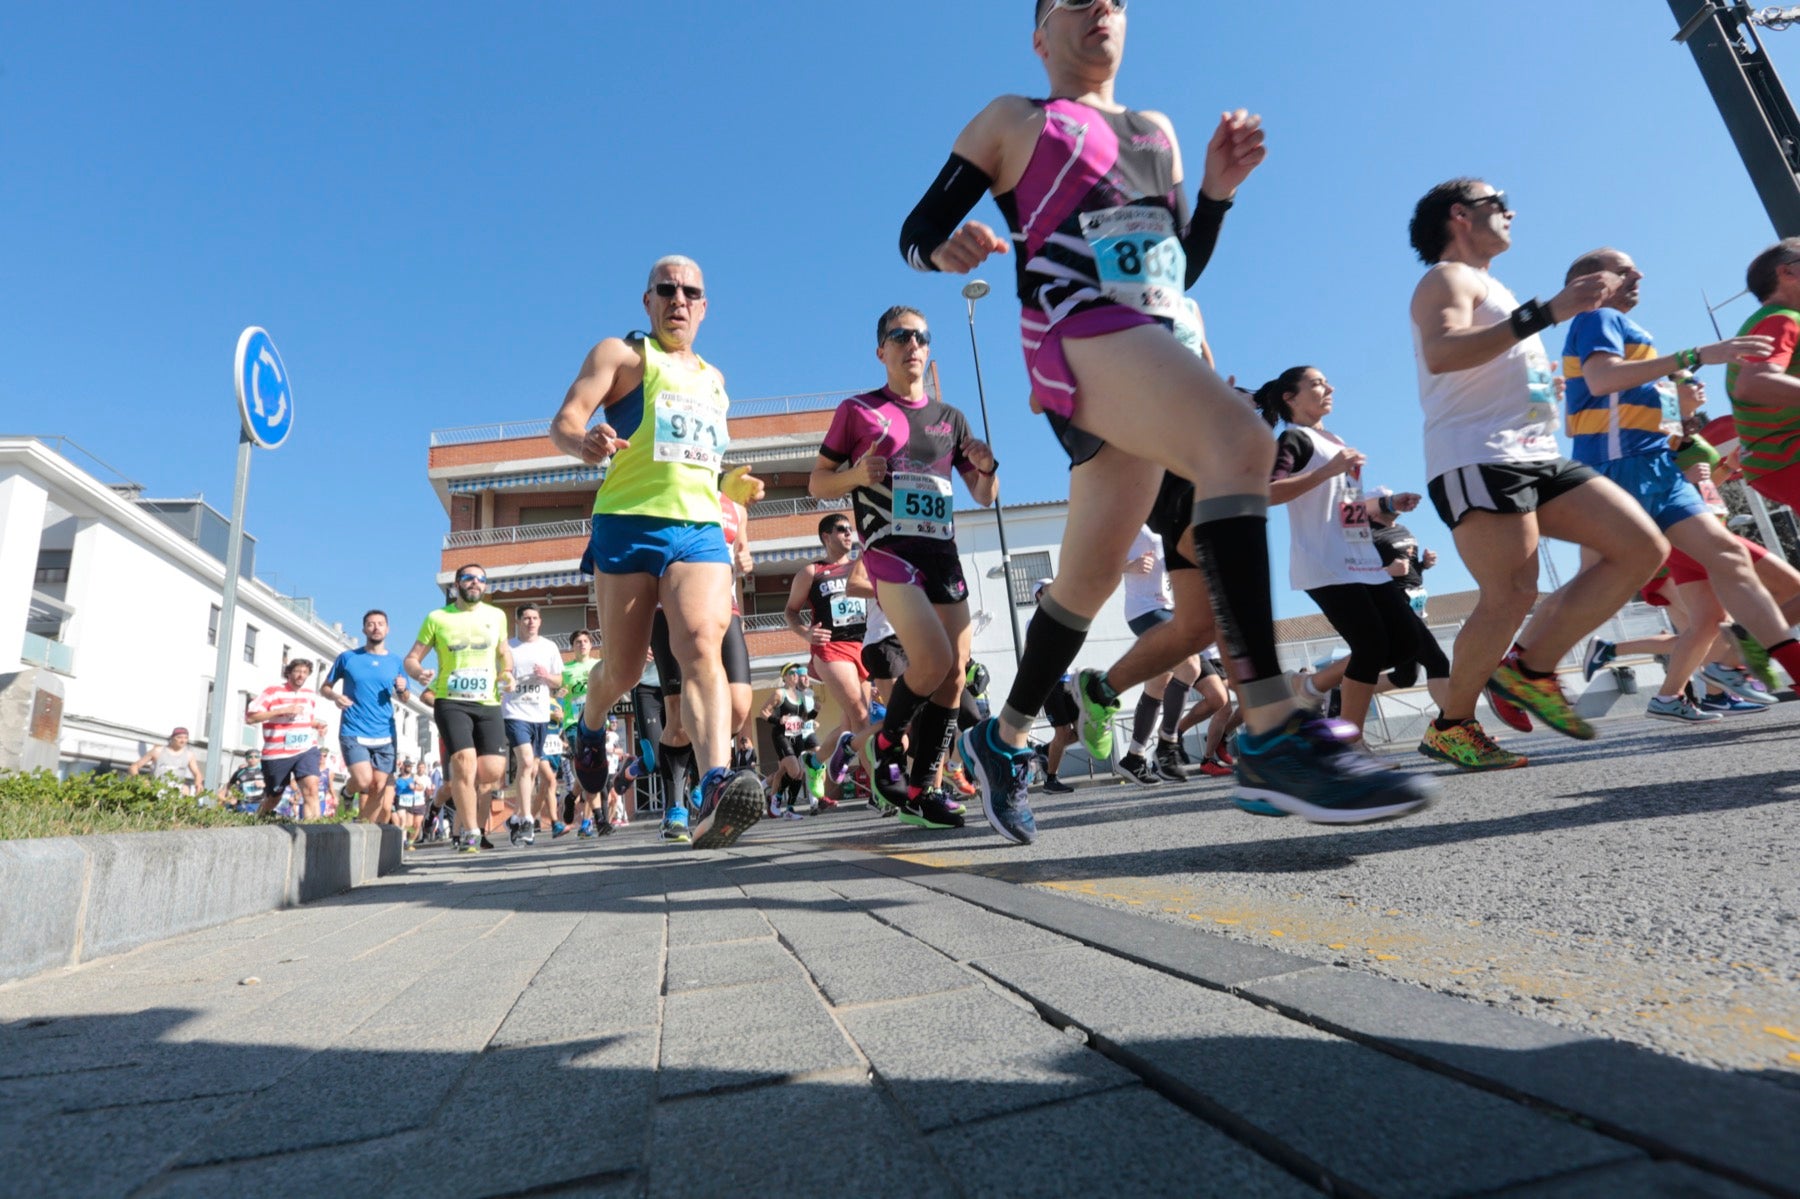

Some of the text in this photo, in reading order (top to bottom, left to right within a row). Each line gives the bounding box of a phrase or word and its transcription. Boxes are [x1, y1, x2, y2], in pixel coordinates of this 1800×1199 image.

[670, 414, 718, 447] 971
[905, 493, 946, 519] 538
[451, 676, 487, 690] 1093
[291, 734, 309, 743] 367
